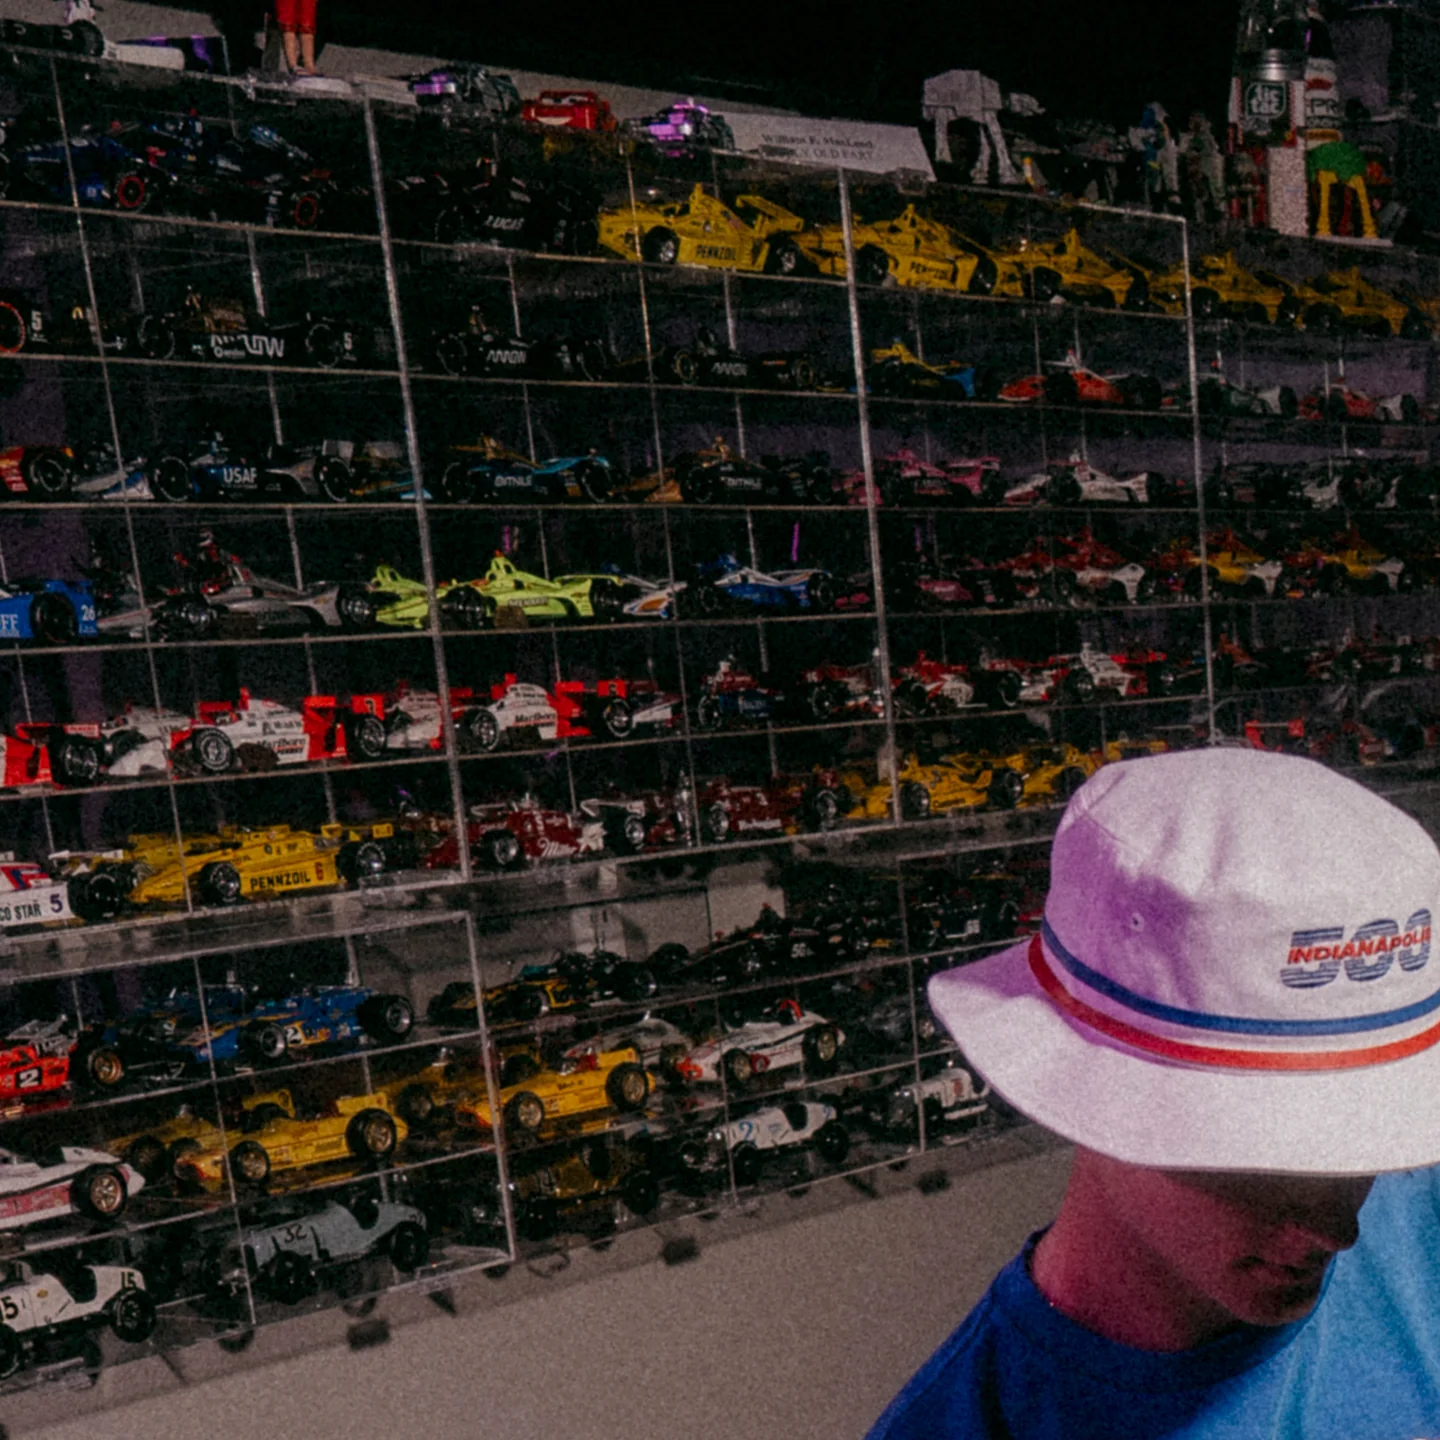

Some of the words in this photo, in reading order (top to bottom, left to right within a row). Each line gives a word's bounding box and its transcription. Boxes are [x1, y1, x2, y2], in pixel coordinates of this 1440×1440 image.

[31, 308, 43, 332] 5
[222, 466, 258, 484] USAF
[80, 603, 96, 622] 26
[250, 870, 311, 891] PENNZOIL
[14, 903, 42, 921] STAR
[50, 893, 63, 913] 5
[1280, 907, 1433, 989] 500
[1287, 924, 1433, 965] INDIANAPOLIS
[18, 1069, 41, 1089] 2
[739, 1121, 755, 1142] 2
[279, 1222, 308, 1243] 32
[121, 1271, 137, 1289] 15
